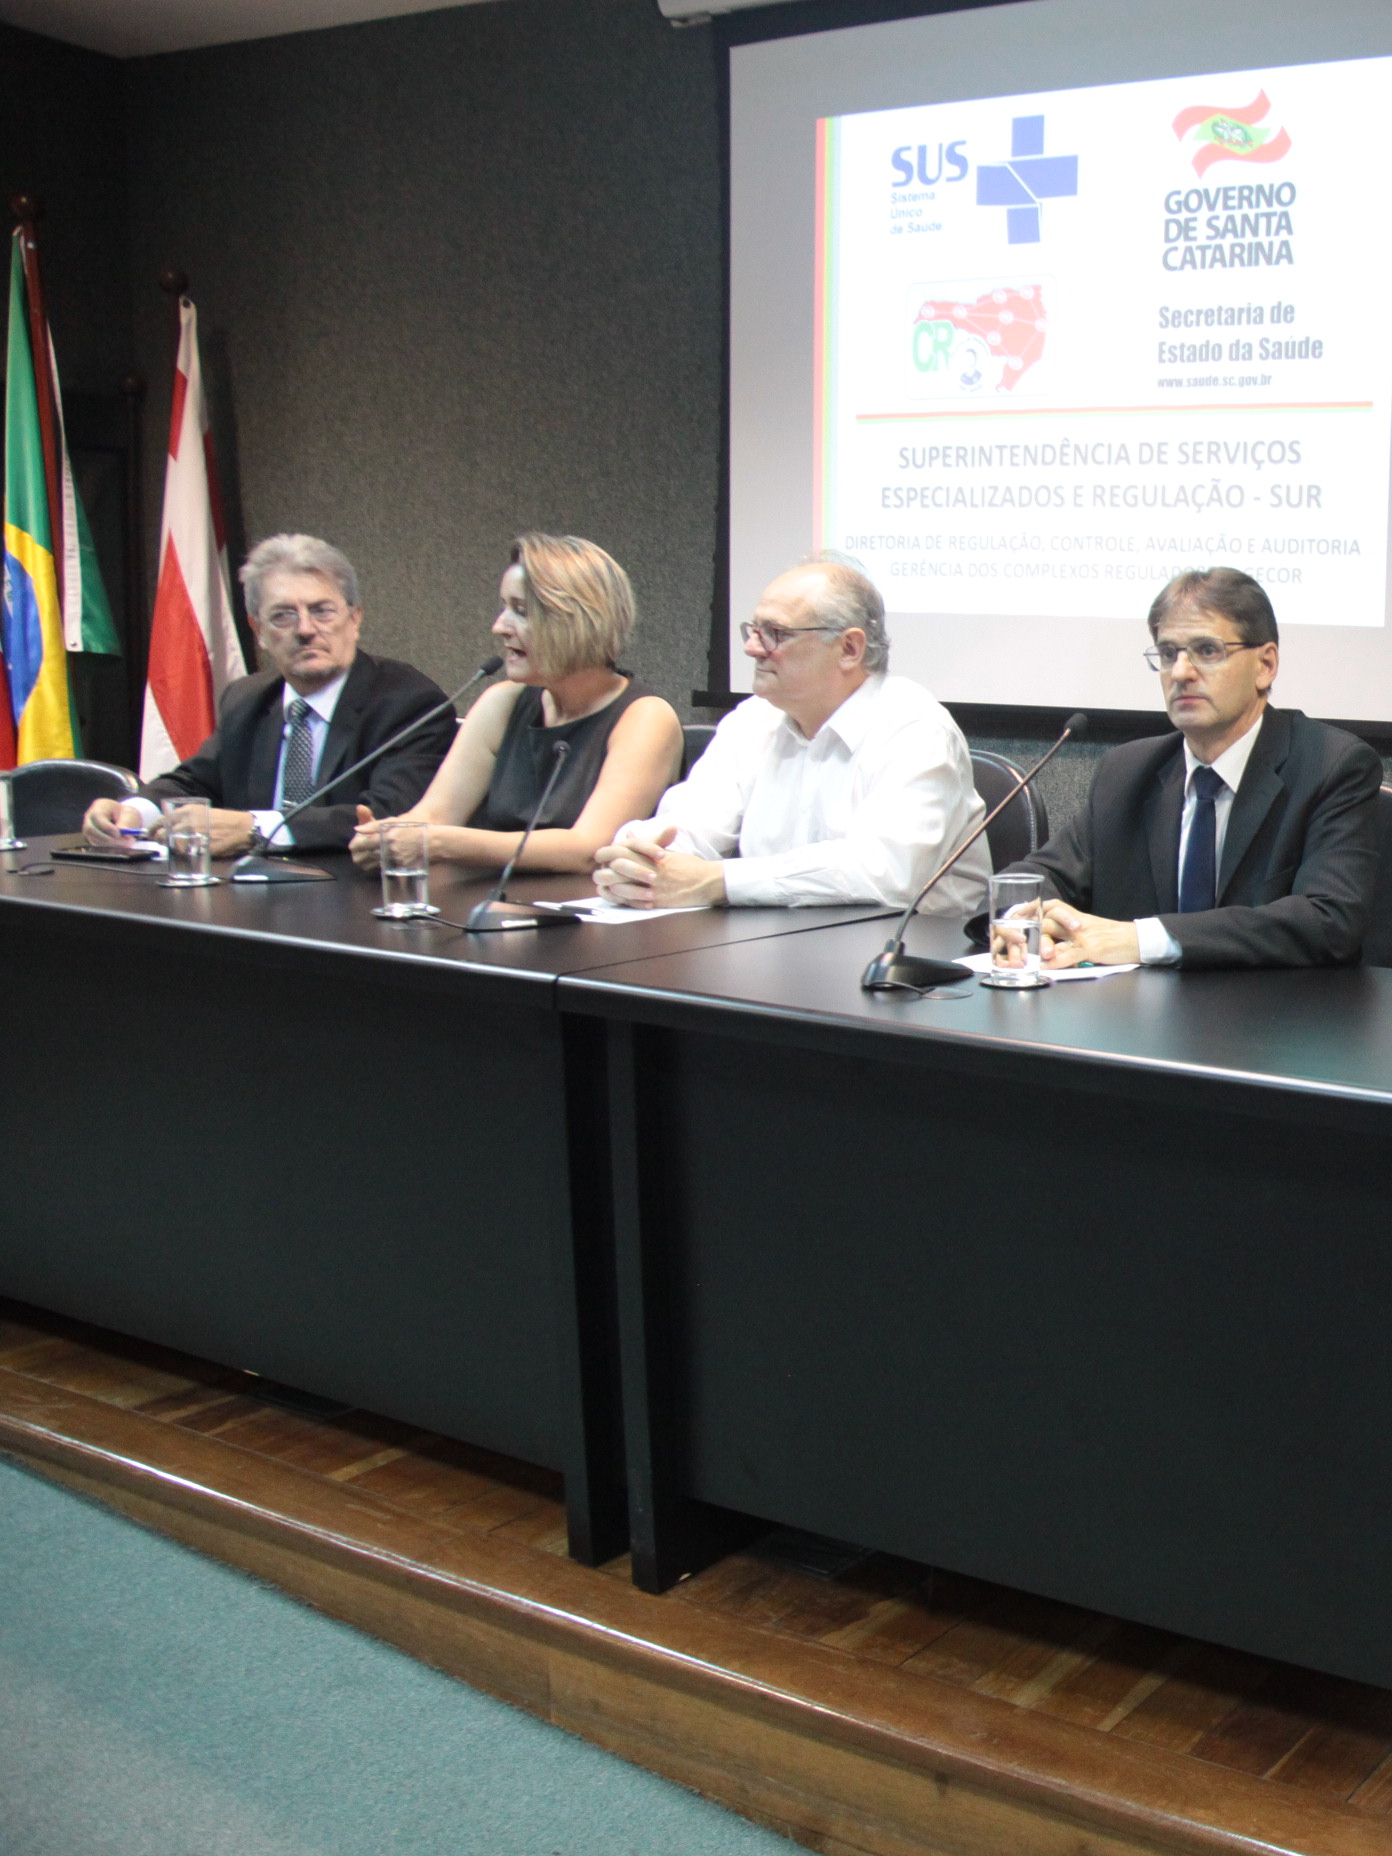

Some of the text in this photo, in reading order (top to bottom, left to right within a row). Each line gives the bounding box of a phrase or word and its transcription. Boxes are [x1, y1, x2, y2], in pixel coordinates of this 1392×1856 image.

[890, 139, 970, 188] SUS
[890, 191, 936, 205] Sistema
[1163, 180, 1297, 217] GOVERNO
[890, 225, 904, 235] de
[1163, 207, 1294, 244] DE SANTA
[1161, 237, 1295, 272] CATARINA
[1158, 300, 1296, 330] Secretaria de
[1156, 335, 1324, 365] Estado da Saúde
[1157, 373, 1273, 388] www.saude.sc.gov.br
[898, 437, 1302, 471] SUPERINTENDÊNCIA DE SERVIÇOS
[881, 484, 1065, 509] ESPECIALIZADOS
[1073, 484, 1084, 508] E
[1092, 477, 1245, 513] REGULAÇÃO
[1270, 483, 1322, 509] SUR
[845, 532, 1361, 556] DIRETORIA DE REGULAÇÃO, CONTROLE, AVALIAÇÃO E AUDITORIA
[890, 558, 963, 577] GERÊNCIA
[968, 562, 998, 578] DOS
[1003, 563, 1099, 580] COMPLEXOS
